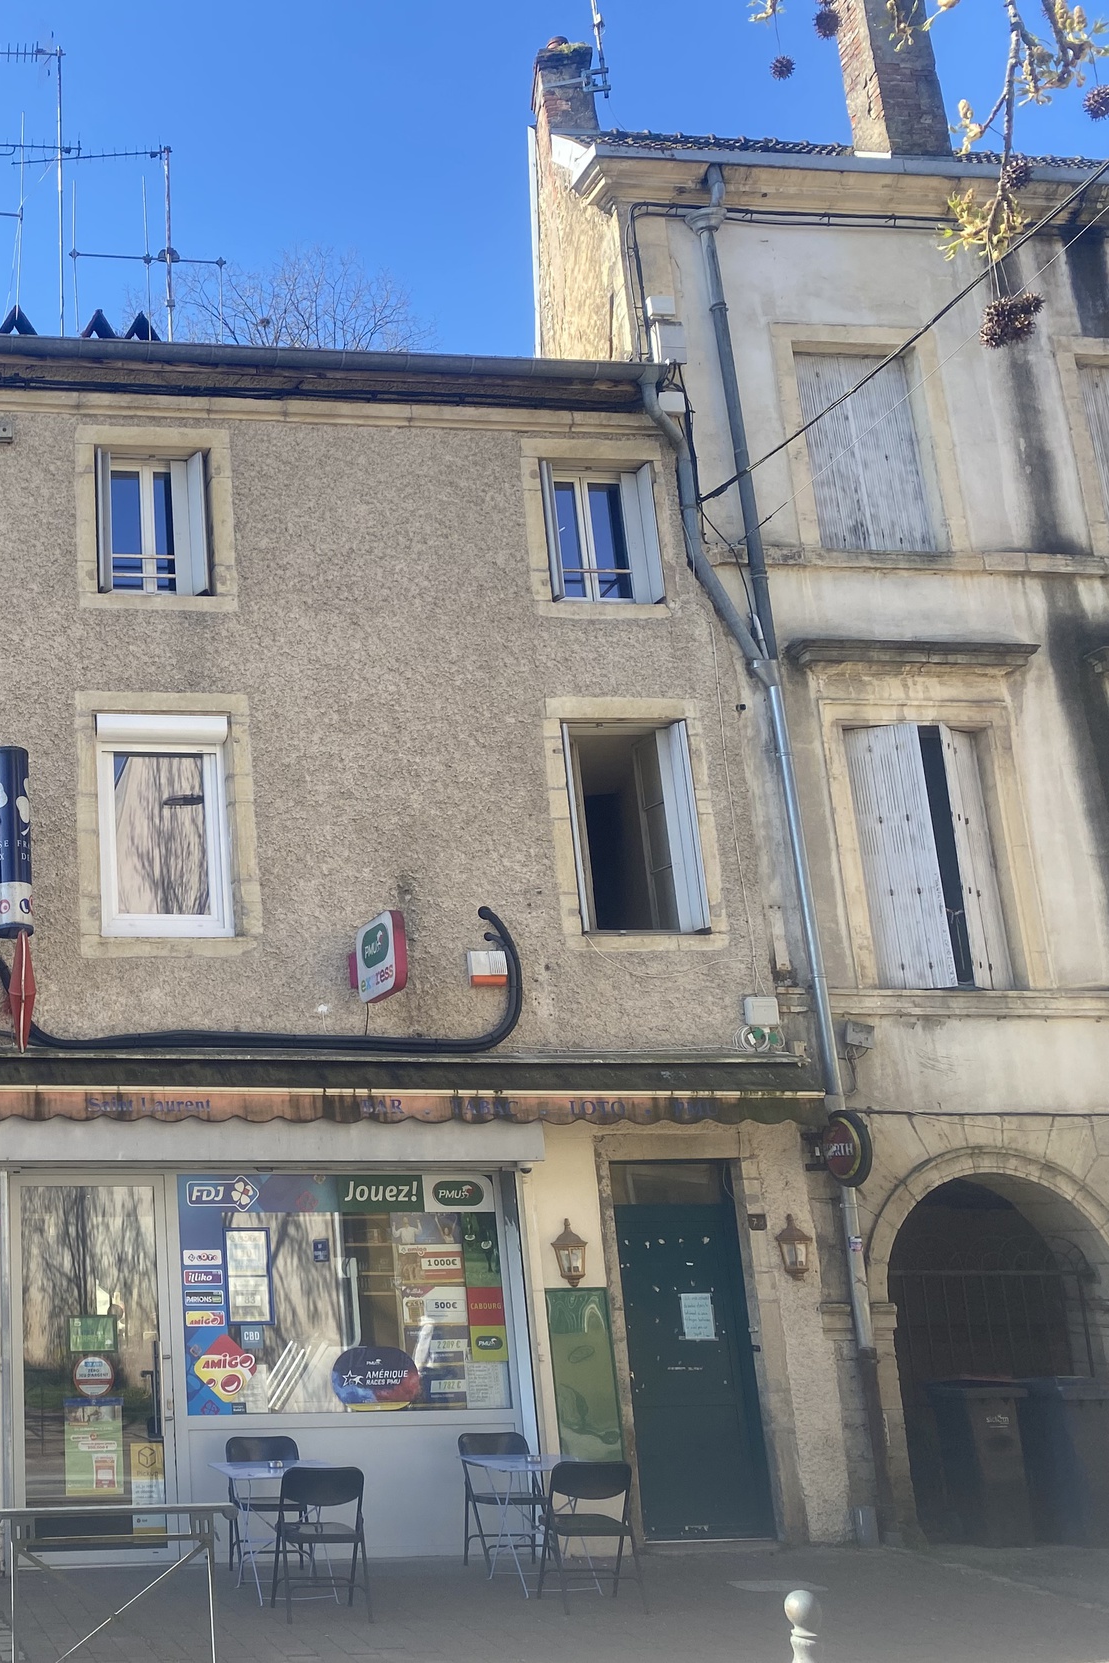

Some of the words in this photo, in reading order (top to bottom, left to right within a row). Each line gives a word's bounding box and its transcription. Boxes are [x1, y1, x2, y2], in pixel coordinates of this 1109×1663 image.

[364, 942, 377, 959] PMU
[360, 964, 394, 993] exress
[87, 1098, 133, 1112] Saint
[141, 1098, 211, 1112] Laurent
[361, 1099, 404, 1114] BAR
[452, 1100, 519, 1115] TABAC
[569, 1100, 626, 1116] LOTO
[673, 1101, 719, 1116] PMU
[192, 1186, 224, 1201] FDJ
[344, 1181, 418, 1202] Jouez!
[438, 1189, 462, 1199] PMU
[196, 1253, 218, 1261] LOTO
[188, 1272, 213, 1283] illiko
[434, 1301, 458, 1309] 500€
[244, 1331, 260, 1341] CBD
[366, 1369, 409, 1379] AMÉRIQUE
